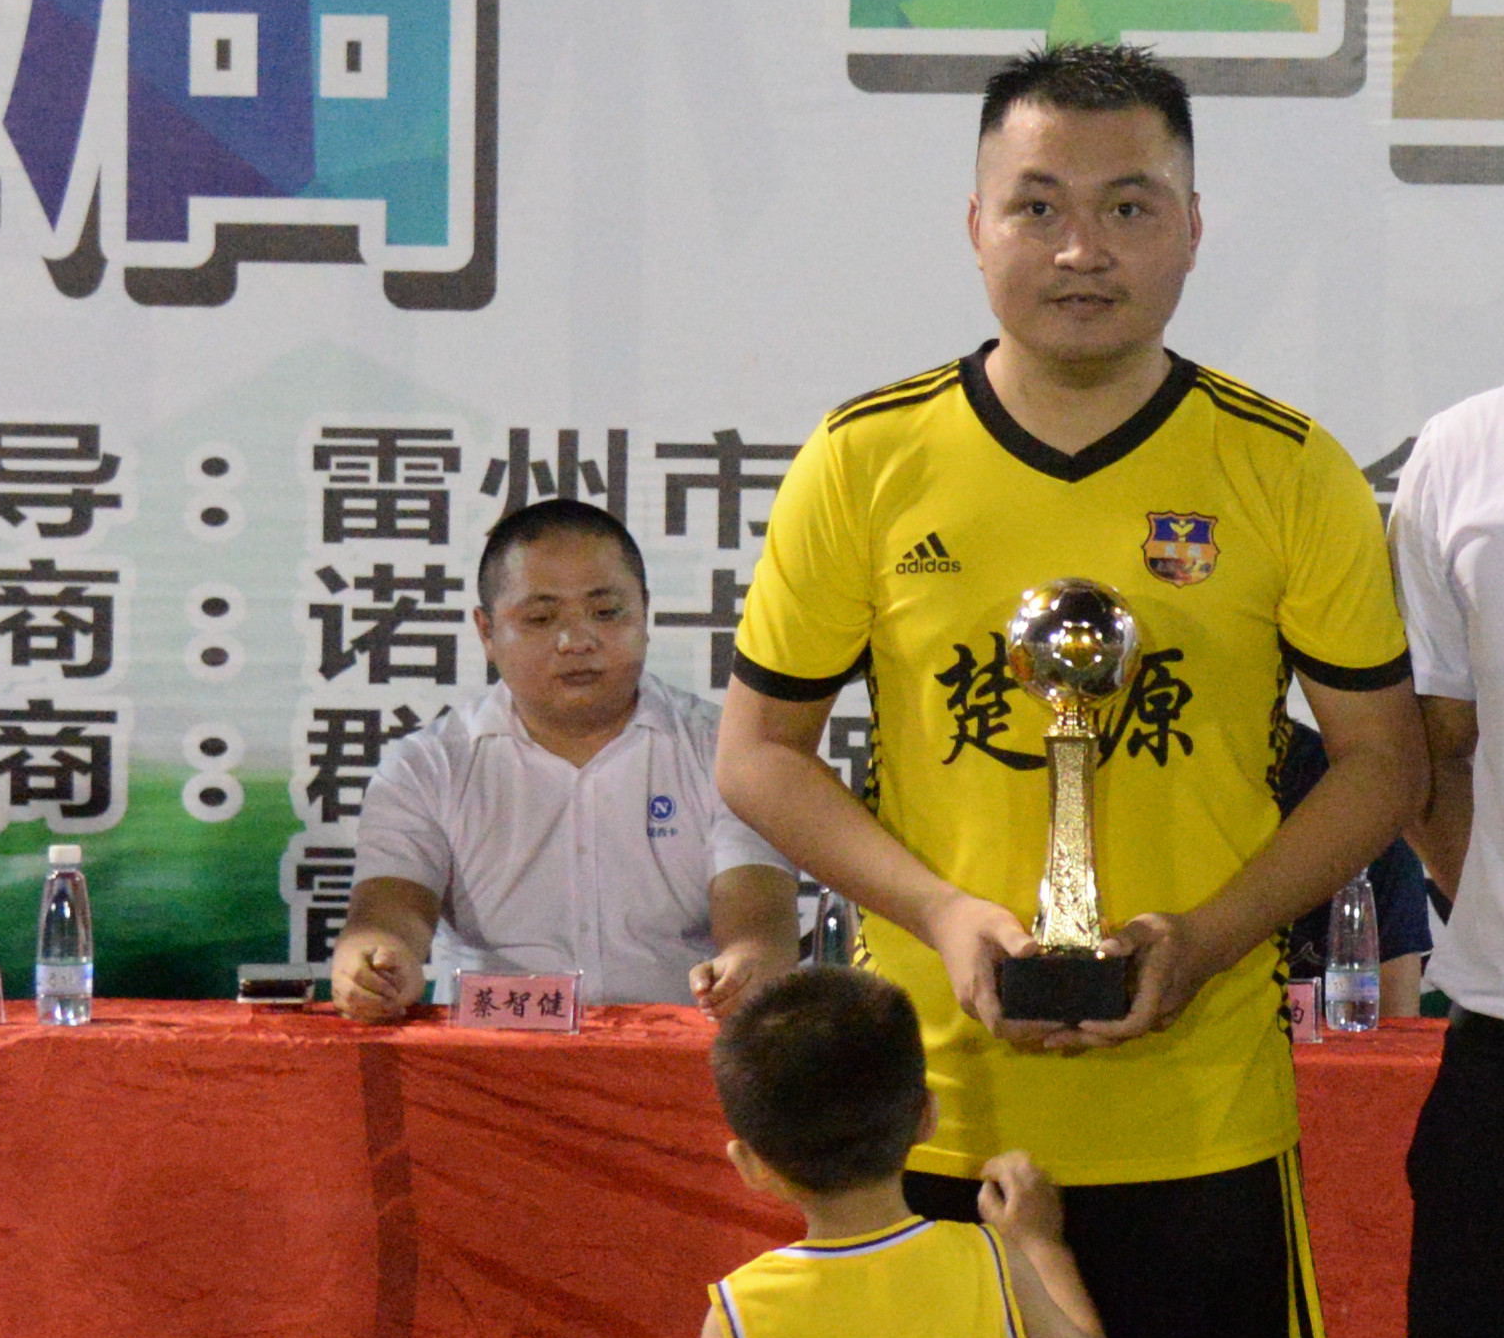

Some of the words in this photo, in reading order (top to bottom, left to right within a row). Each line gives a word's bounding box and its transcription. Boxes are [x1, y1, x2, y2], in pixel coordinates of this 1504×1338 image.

[896, 557, 962, 575] adidas
[470, 988, 568, 1020] 蔡智健
